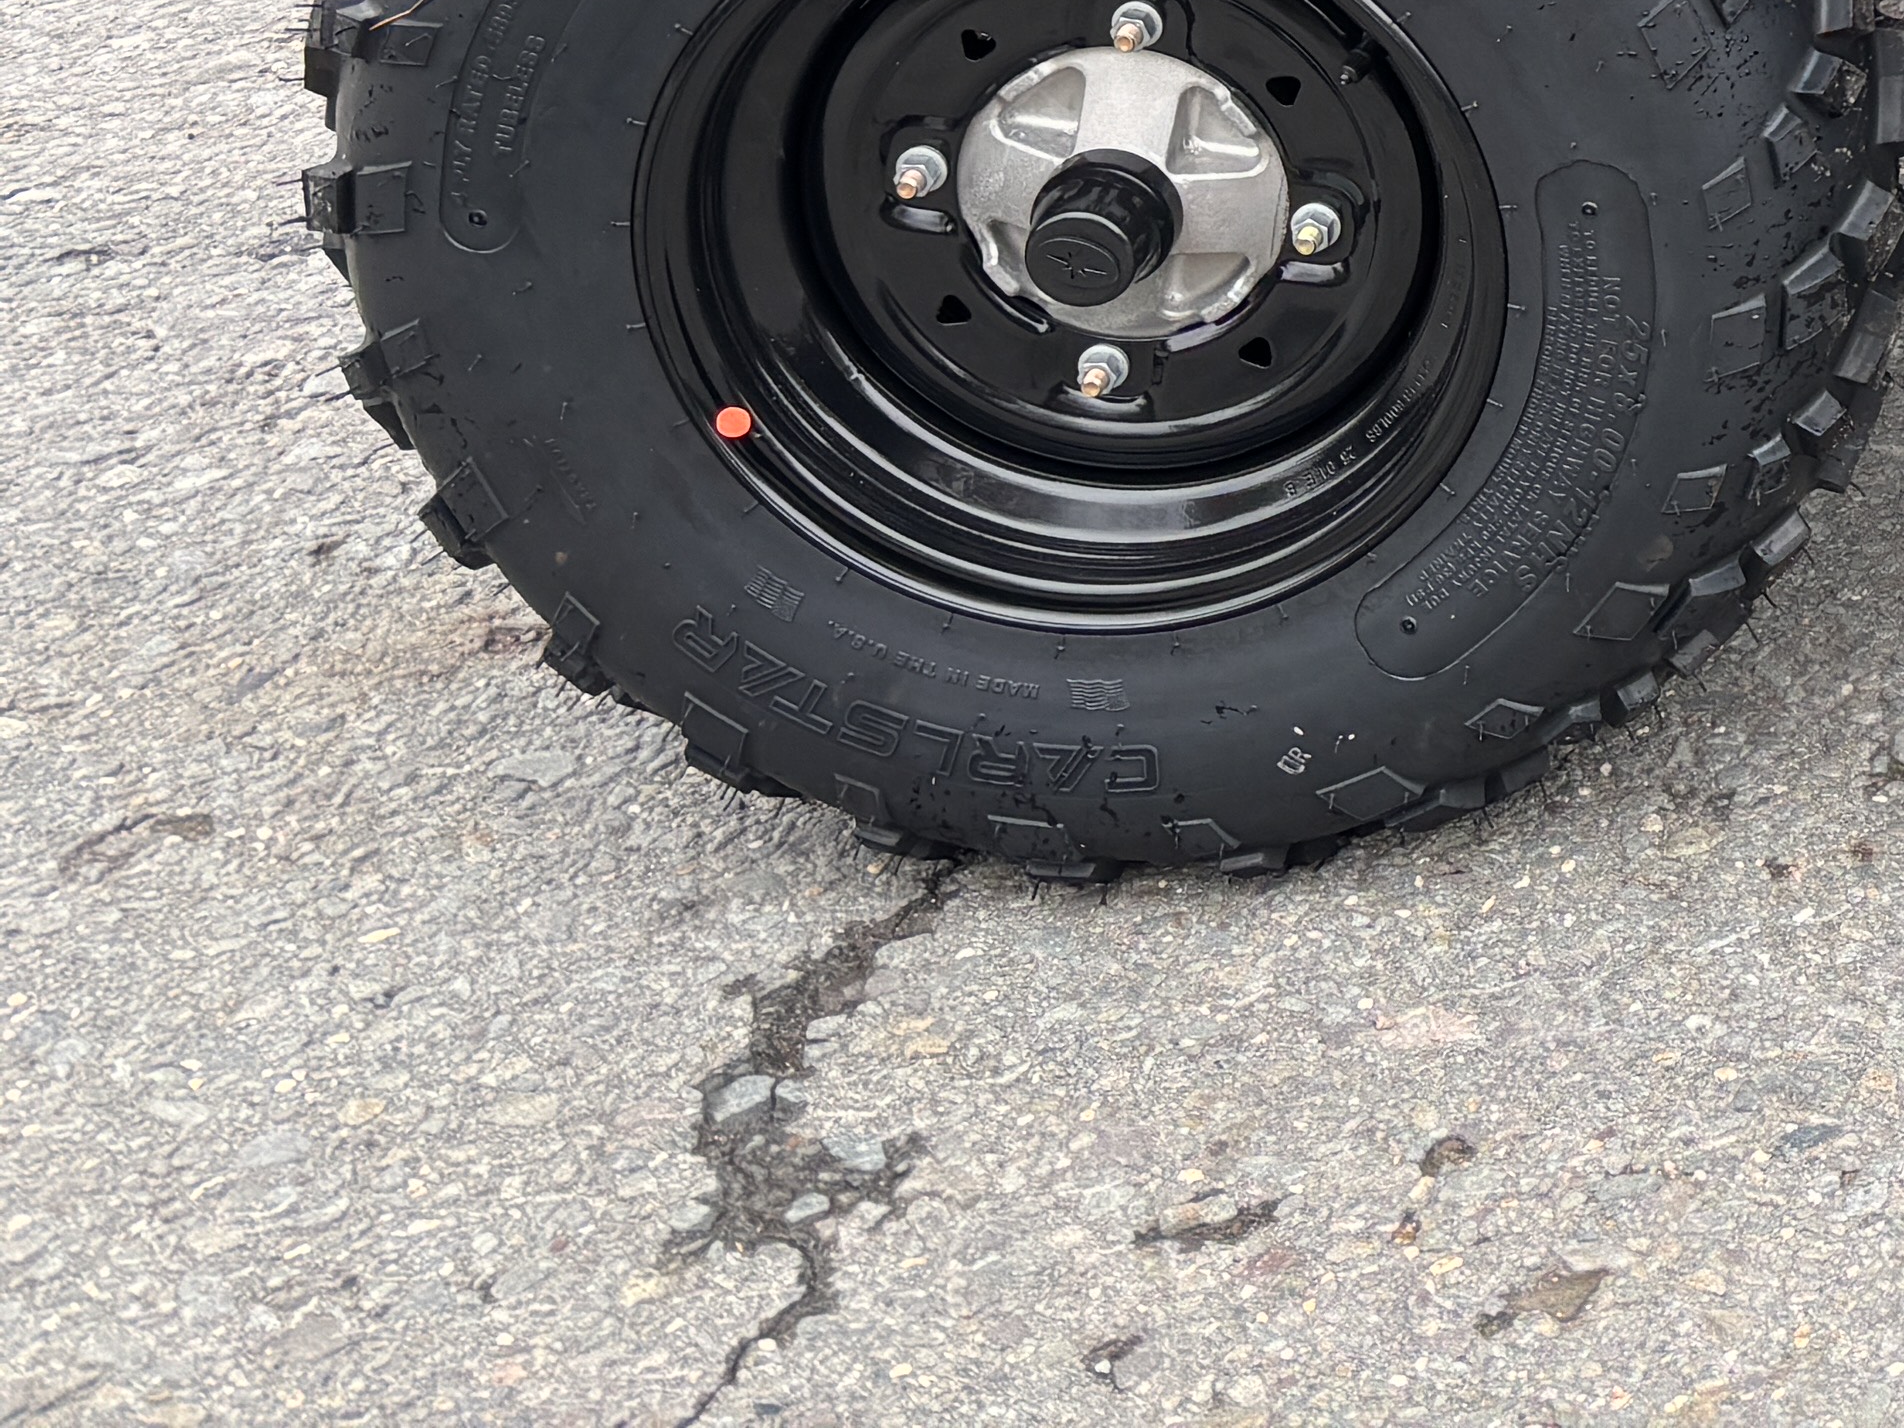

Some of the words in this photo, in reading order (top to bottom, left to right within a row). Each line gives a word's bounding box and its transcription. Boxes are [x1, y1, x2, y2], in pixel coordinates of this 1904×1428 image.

[1542, 395, 1612, 502] HIGHWAY
[1463, 507, 1553, 601] SERVICE
[890, 648, 940, 679] THE
[942, 665, 970, 688] IN
[974, 673, 1040, 699] MADE
[671, 603, 1164, 795] CARLSTAR
